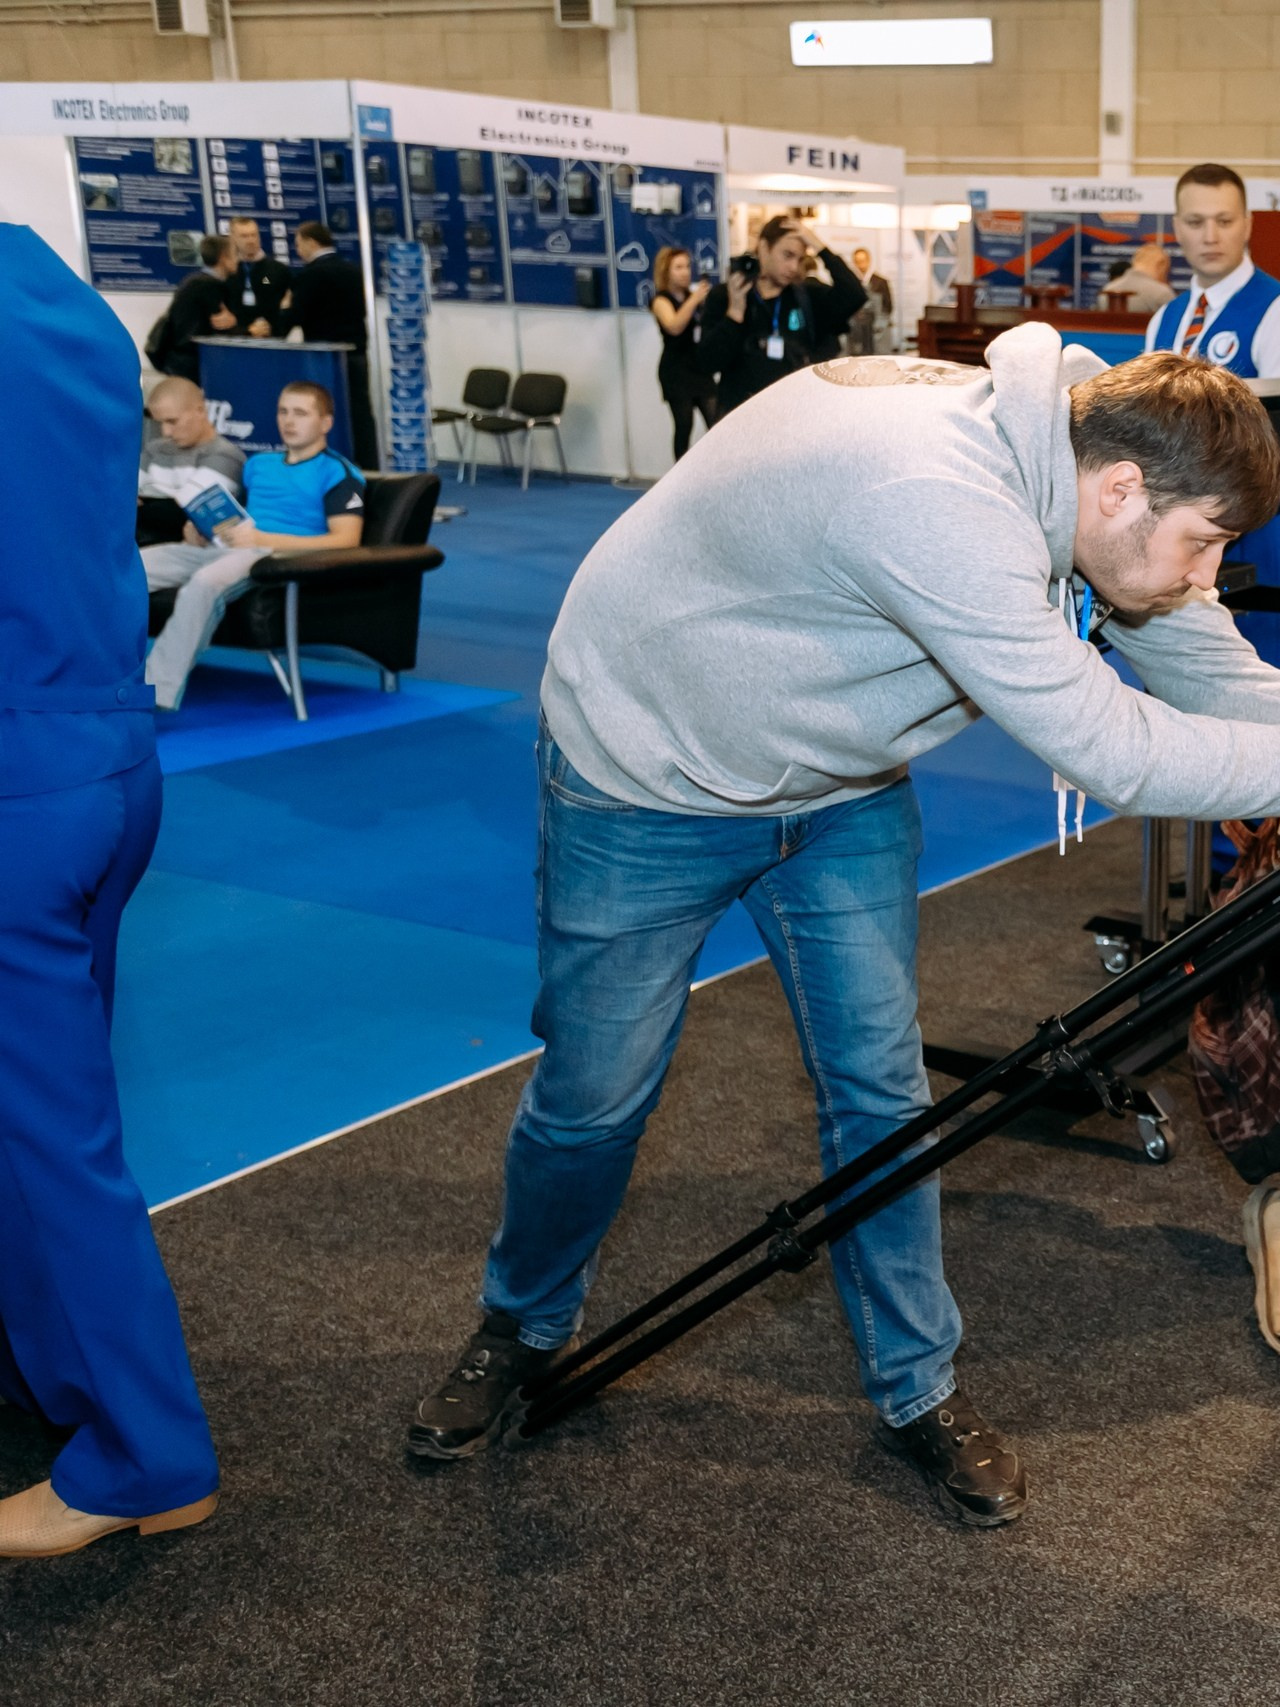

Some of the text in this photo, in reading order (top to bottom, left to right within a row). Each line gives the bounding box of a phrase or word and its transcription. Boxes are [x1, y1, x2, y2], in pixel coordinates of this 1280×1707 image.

[52, 99, 190, 125] INCOTEX Electronics Group
[517, 107, 594, 130] INCOTEX
[479, 126, 631, 156] Electronics Group
[786, 144, 861, 172] FEIN
